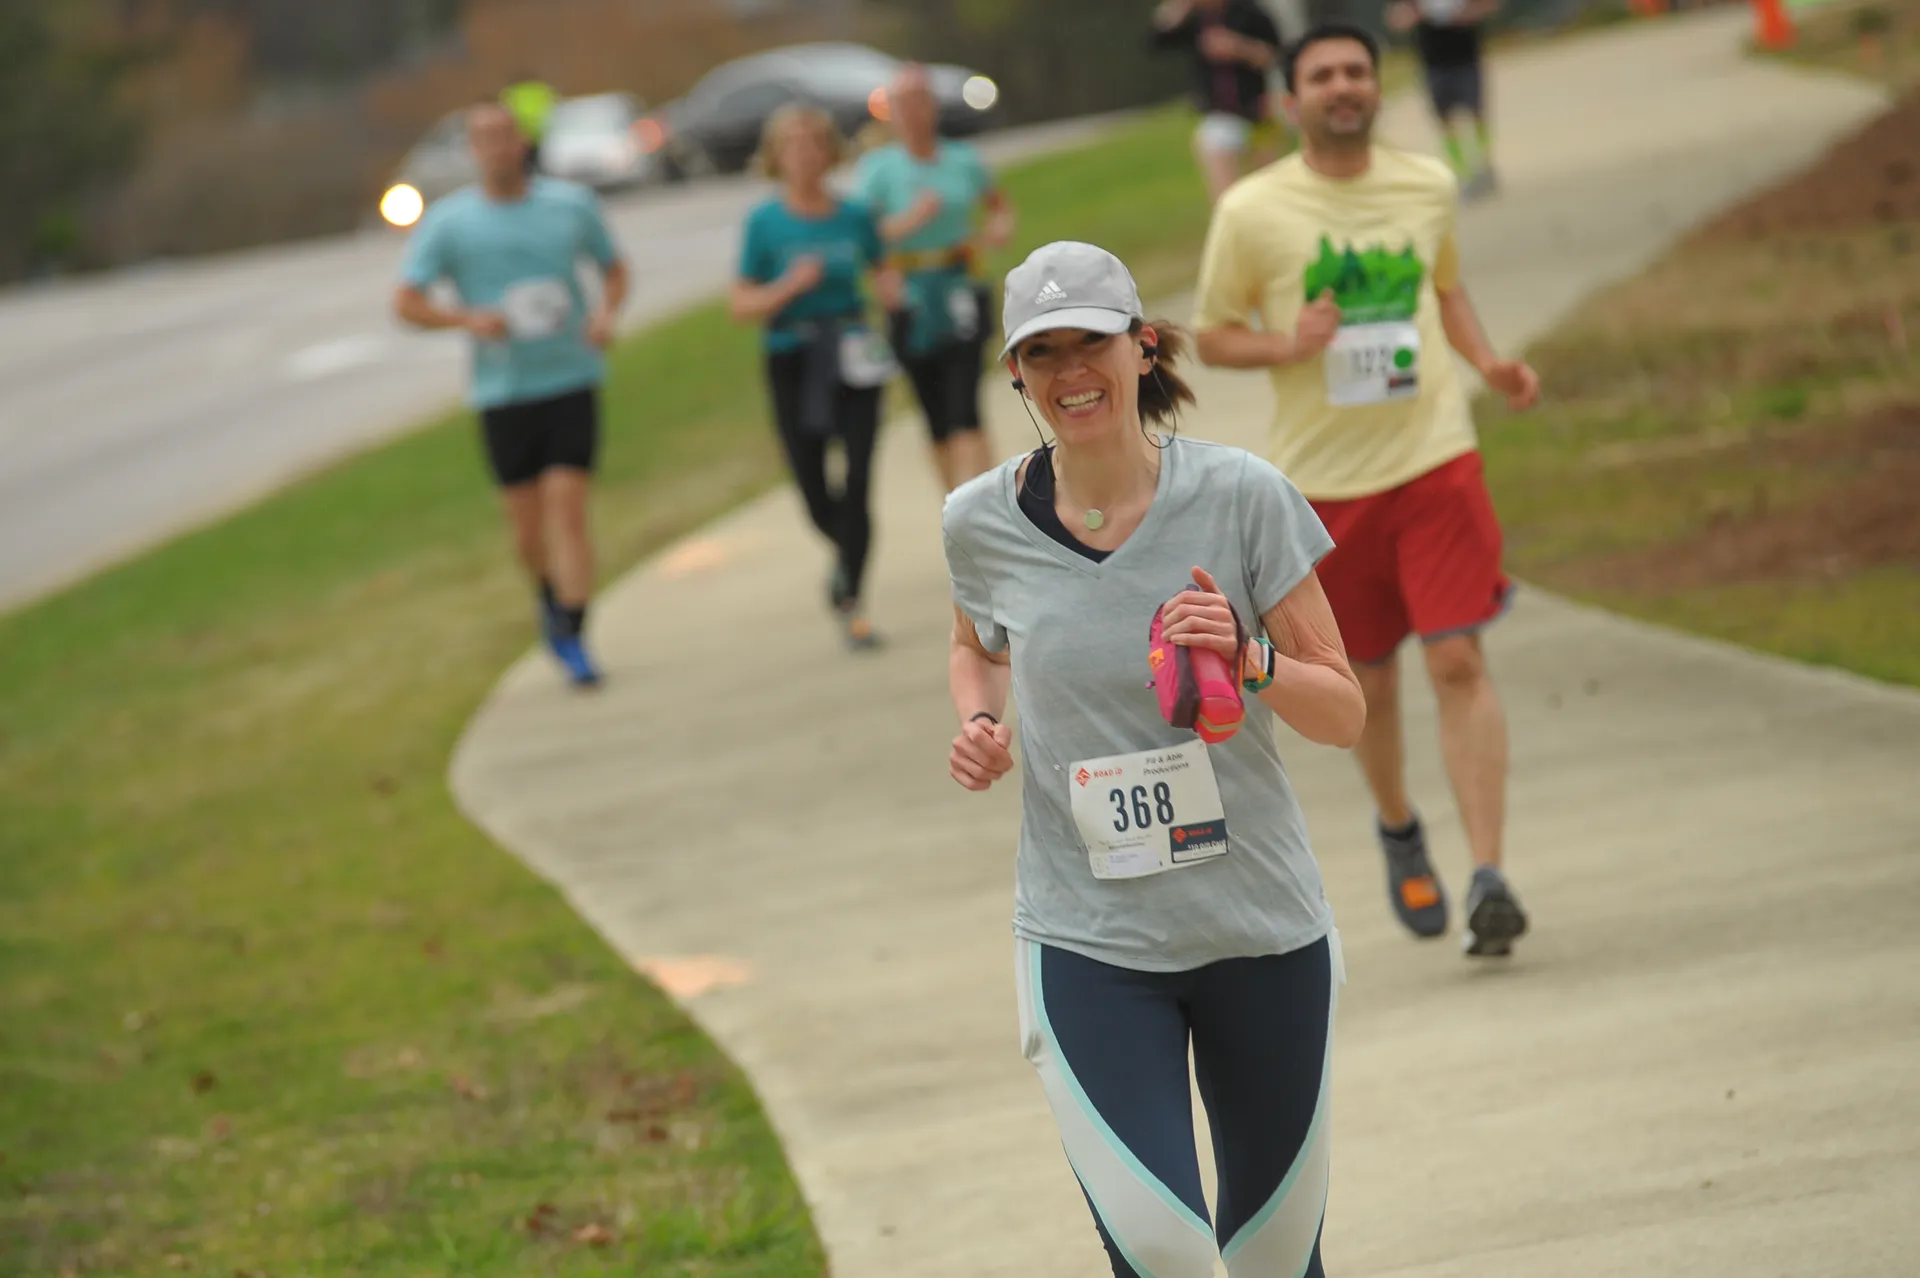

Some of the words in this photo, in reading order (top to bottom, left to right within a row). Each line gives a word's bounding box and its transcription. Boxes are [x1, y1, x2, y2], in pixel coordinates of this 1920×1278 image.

[1035, 291, 1067, 304] adidas
[1094, 769, 1114, 778] ROAD
[1109, 781, 1175, 832] 368
